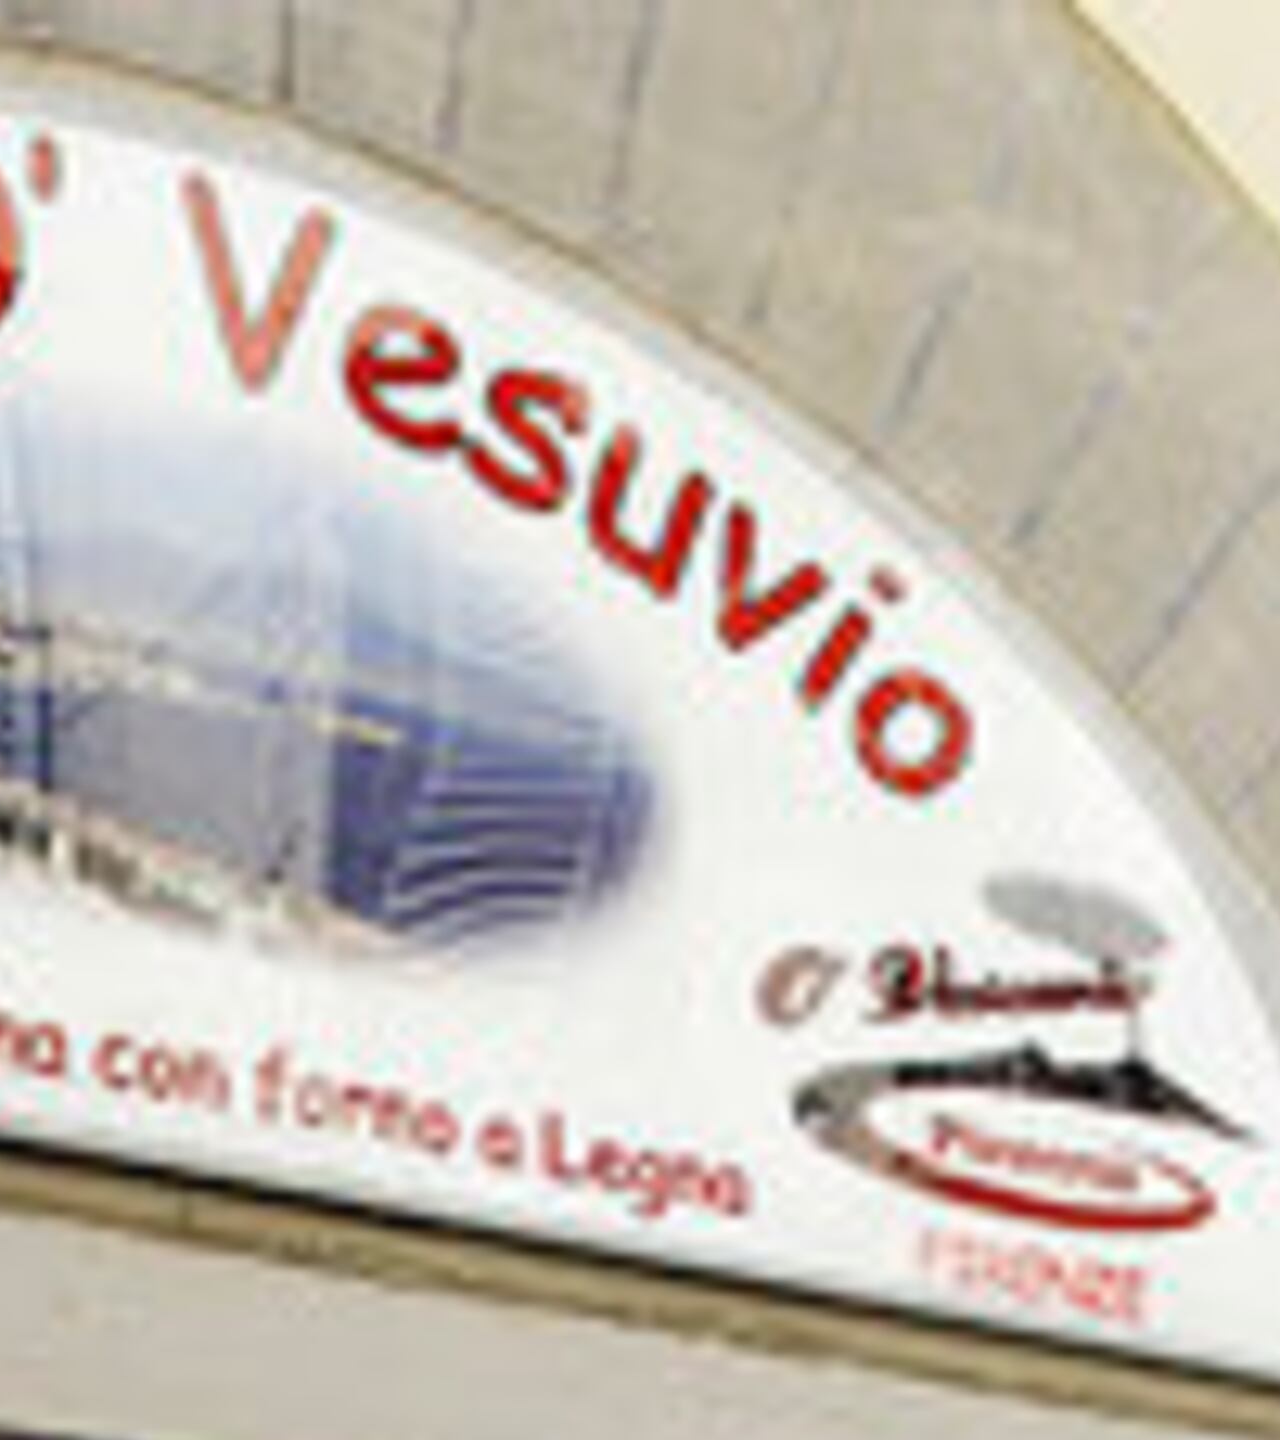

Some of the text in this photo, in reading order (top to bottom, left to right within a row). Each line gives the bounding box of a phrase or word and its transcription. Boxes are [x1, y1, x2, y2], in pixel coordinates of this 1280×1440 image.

[180, 166, 976, 798] Vesuvio
[90, 1032, 230, 1112] con
[252, 1045, 462, 1156] forno
[538, 1110, 752, 1220] Legna
